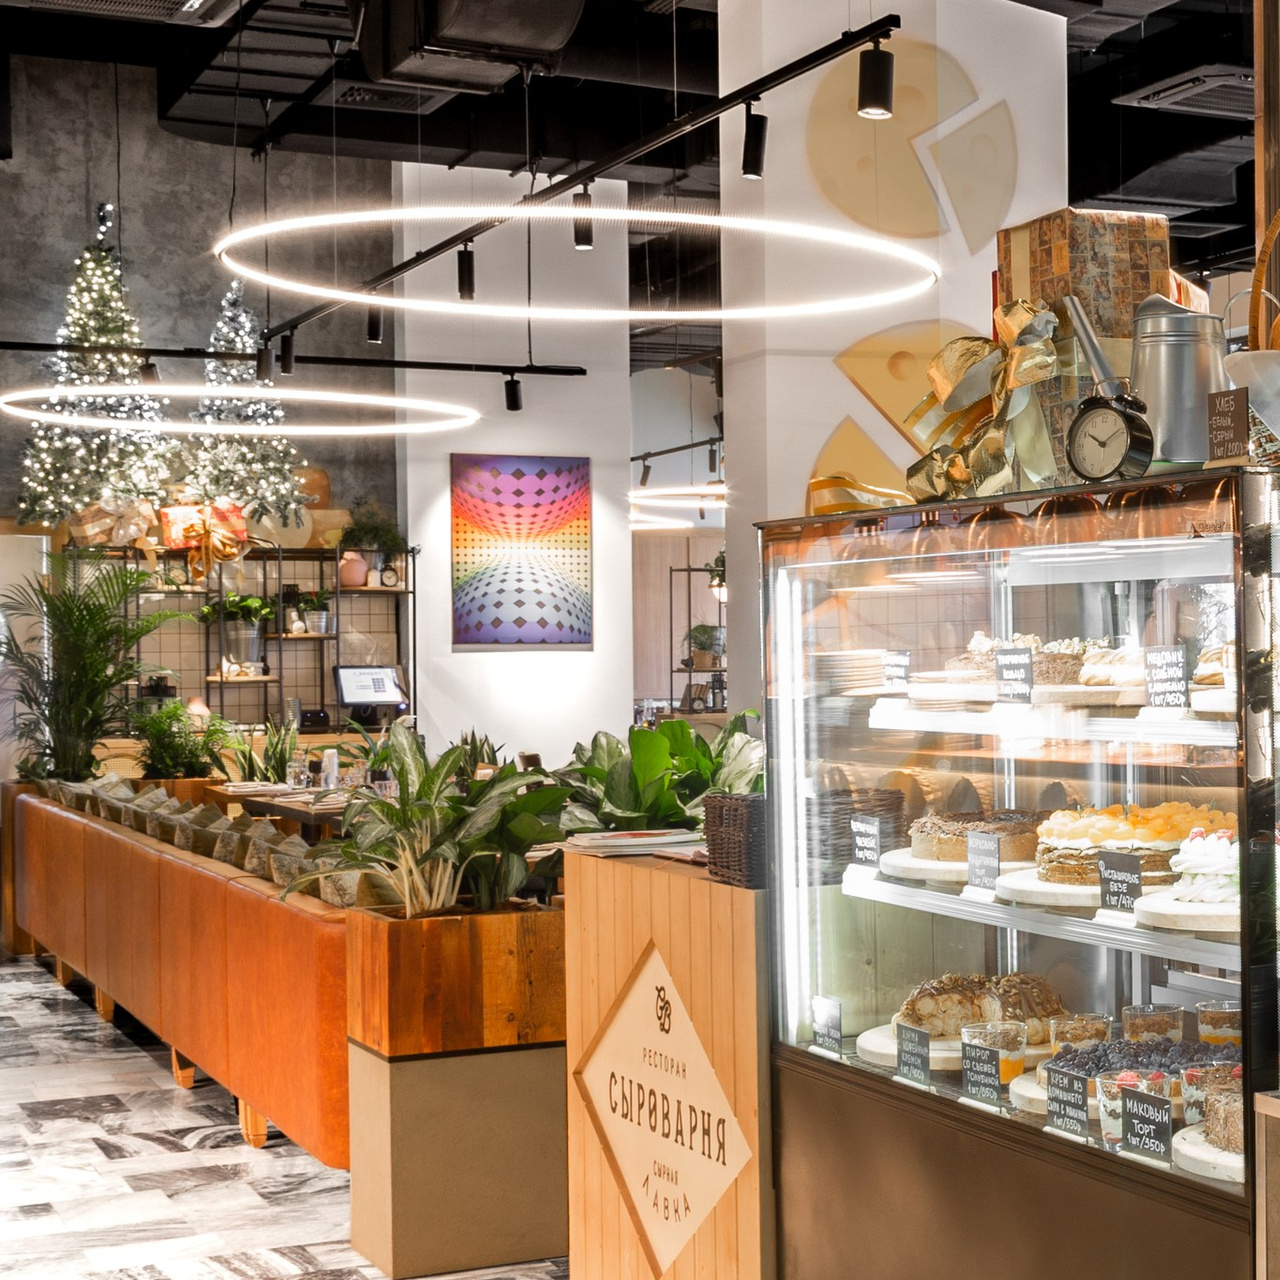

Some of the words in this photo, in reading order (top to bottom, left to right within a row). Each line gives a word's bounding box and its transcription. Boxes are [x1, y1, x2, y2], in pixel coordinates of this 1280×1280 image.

[1215, 395, 1236, 413] ХЛЕБ
[1110, 882, 1128, 892] БЕЗЕ
[642, 1046, 687, 1080] РЕСТОРАН
[965, 1046, 990, 1060] ПИРОГ
[963, 1059, 971, 1069] СО
[972, 1061, 996, 1075] СВЕЖЕЙ
[1050, 1071, 1069, 1088] КРЕМ
[1073, 1079, 1083, 1092] ИЗ
[1048, 1085, 1083, 1105] ДОМАШНЕГО
[609, 1071, 727, 1166] СЫРОВАРНЯ
[1061, 1103, 1065, 1115] С
[1126, 1097, 1170, 1124] МАКОВЫЙ
[1132, 1119, 1156, 1137] ТОРТ
[1127, 1132, 1166, 1156] 1шт/350р
[653, 1160, 678, 1186] СЫРНАЯ
[642, 1174, 691, 1223] ЛАВКА
